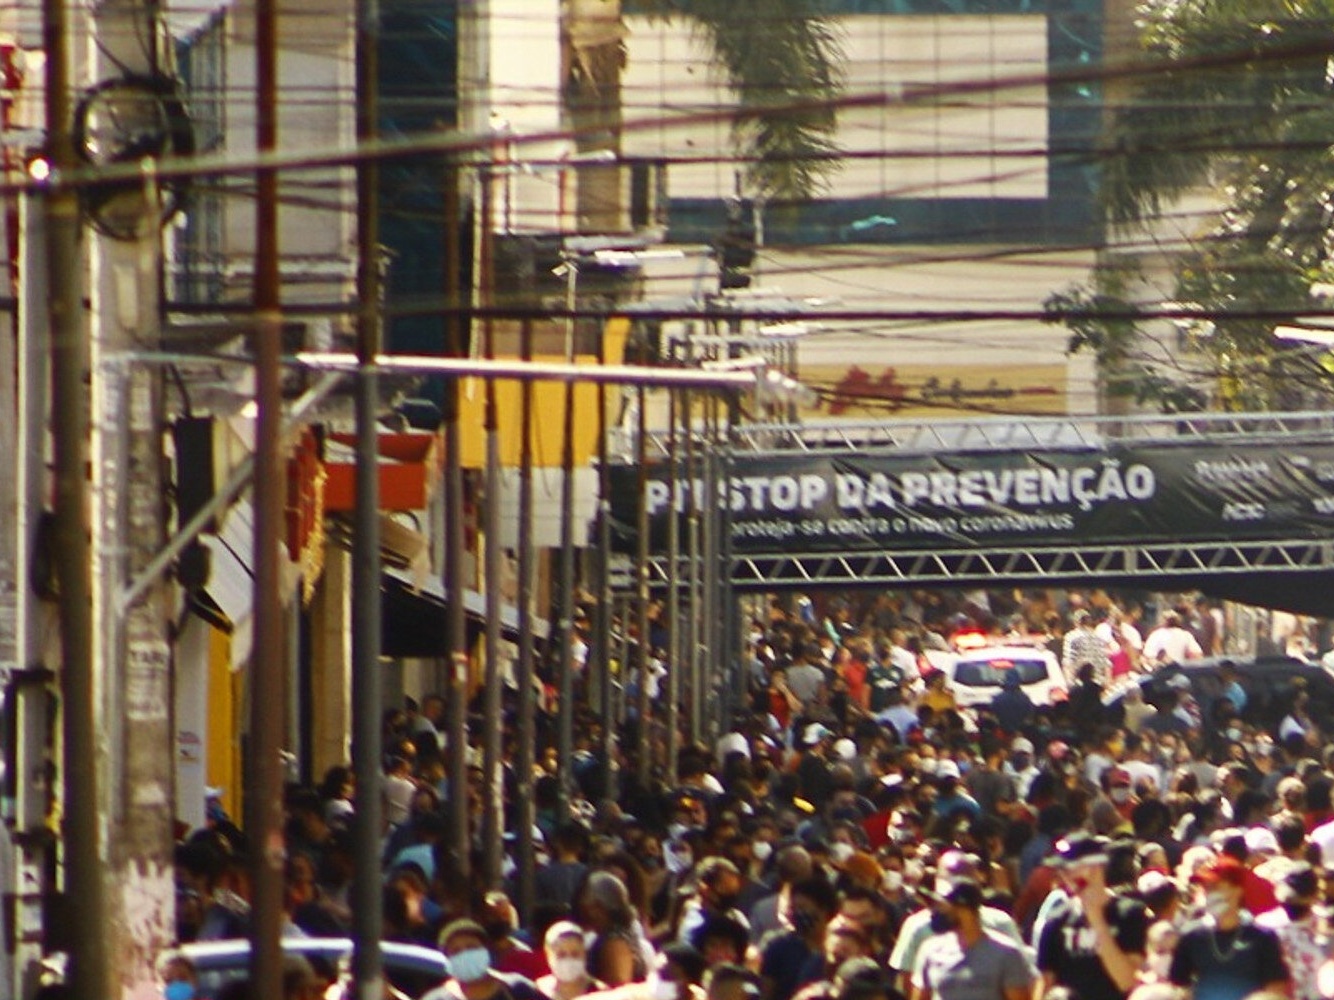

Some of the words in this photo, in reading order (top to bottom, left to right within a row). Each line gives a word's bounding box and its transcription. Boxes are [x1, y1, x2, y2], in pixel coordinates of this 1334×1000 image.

[718, 475, 828, 511] STOP
[836, 471, 893, 508] DA
[900, 457, 1156, 511] PREVENÇÃO
[892, 517, 907, 534] o
[909, 515, 958, 533] novo
